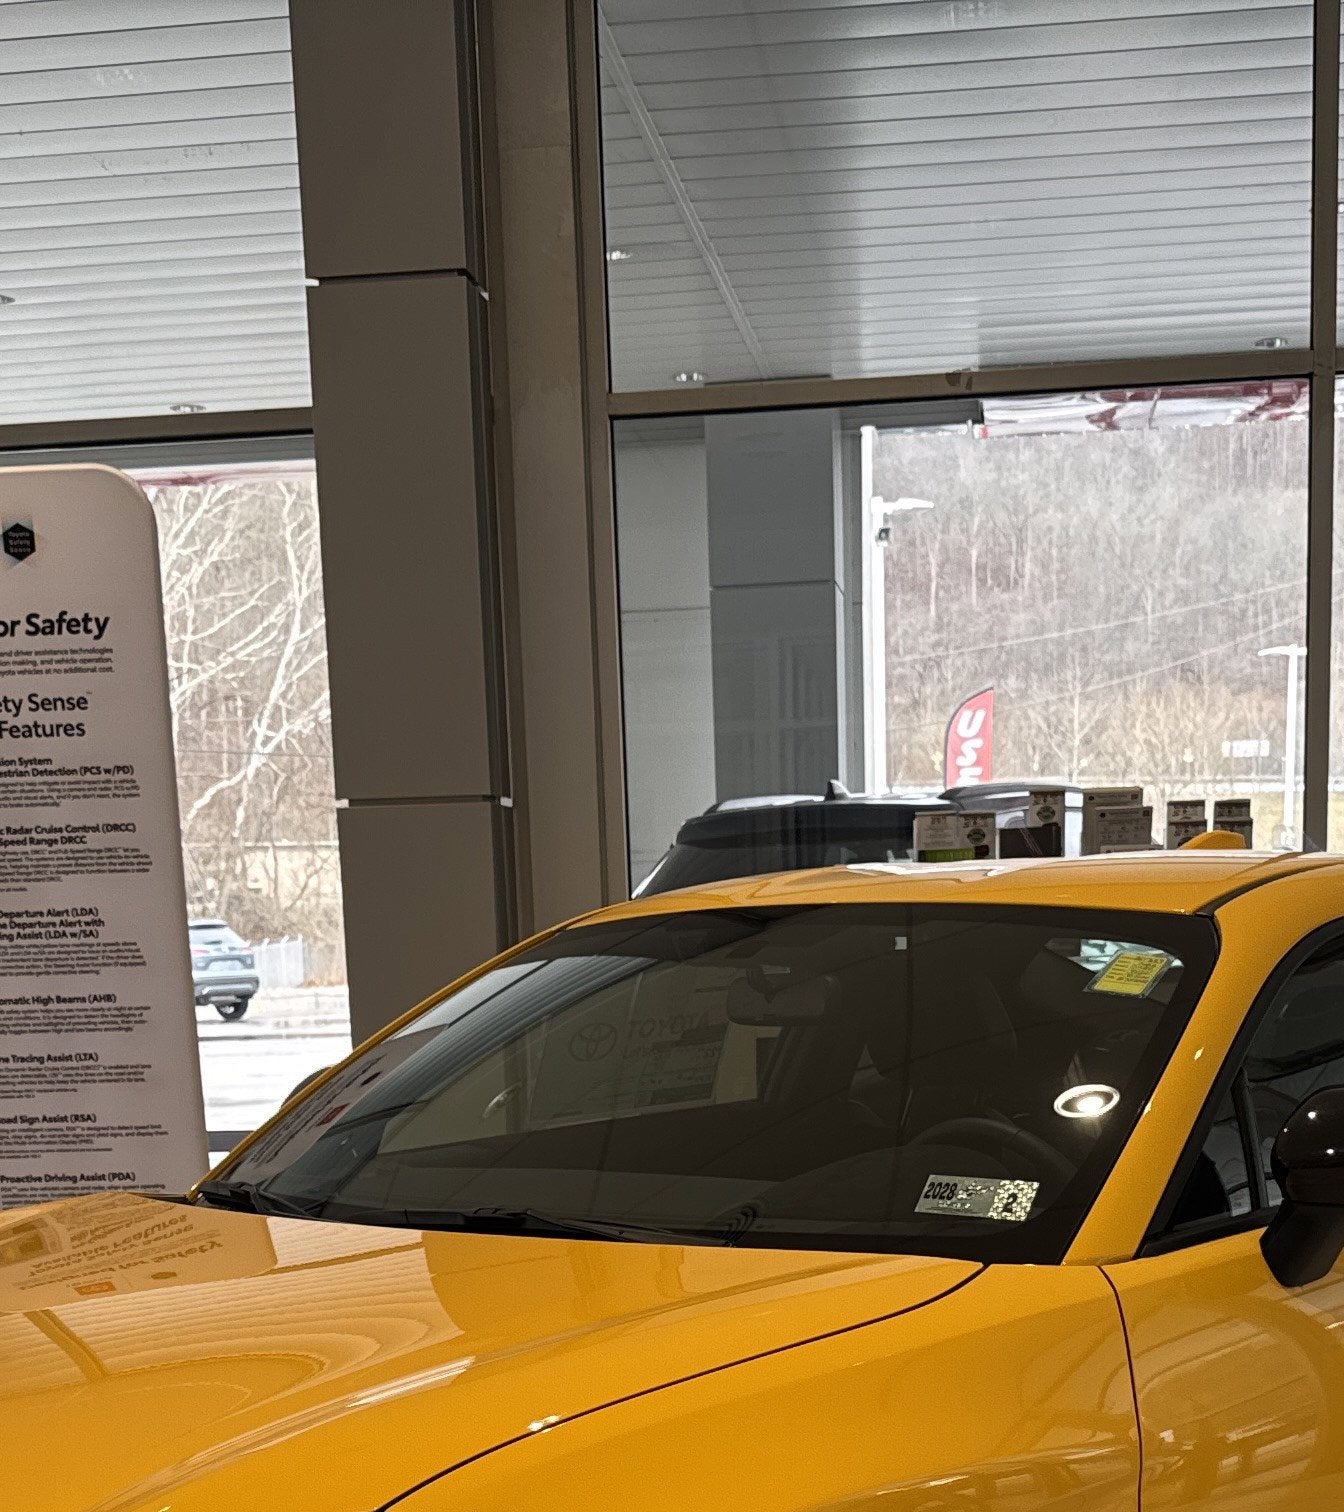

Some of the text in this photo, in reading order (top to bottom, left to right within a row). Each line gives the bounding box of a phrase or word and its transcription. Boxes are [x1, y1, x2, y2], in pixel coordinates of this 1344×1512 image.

[25, 610, 110, 640] Safety
[27, 693, 88, 712] Sense
[18, 757, 52, 767] System
[31, 767, 77, 776] Detection
[5, 826, 32, 834] Radar
[34, 825, 63, 834] Cruise
[64, 824, 100, 835] Control
[101, 822, 135, 833] (DRCC)
[28, 836, 58, 846] Range
[60, 835, 86, 844] DRCC
[46, 908, 69, 916] Alert
[70, 907, 98, 917] (LDA)
[8, 919, 56, 930] Departure
[58, 919, 82, 927] Alert
[83, 918, 104, 929] with
[16, 930, 42, 939] Assist
[31, 995, 54, 1006] High
[55, 995, 86, 1003] Beams
[88, 994, 116, 1003] (AHB)
[11, 1054, 44, 1064] Tracing
[46, 1053, 73, 1062] Assist
[19, 1115, 40, 1125] Sign
[41, 1114, 68, 1122] Assist
[70, 1113, 96, 1122] (RSA)
[44, 1174, 77, 1183] Driving
[79, 1173, 106, 1181] Assist
[108, 1172, 135, 1181] (PDA)
[923, 1181, 958, 1201] 2028
[1001, 1192, 1018, 1214] 2
